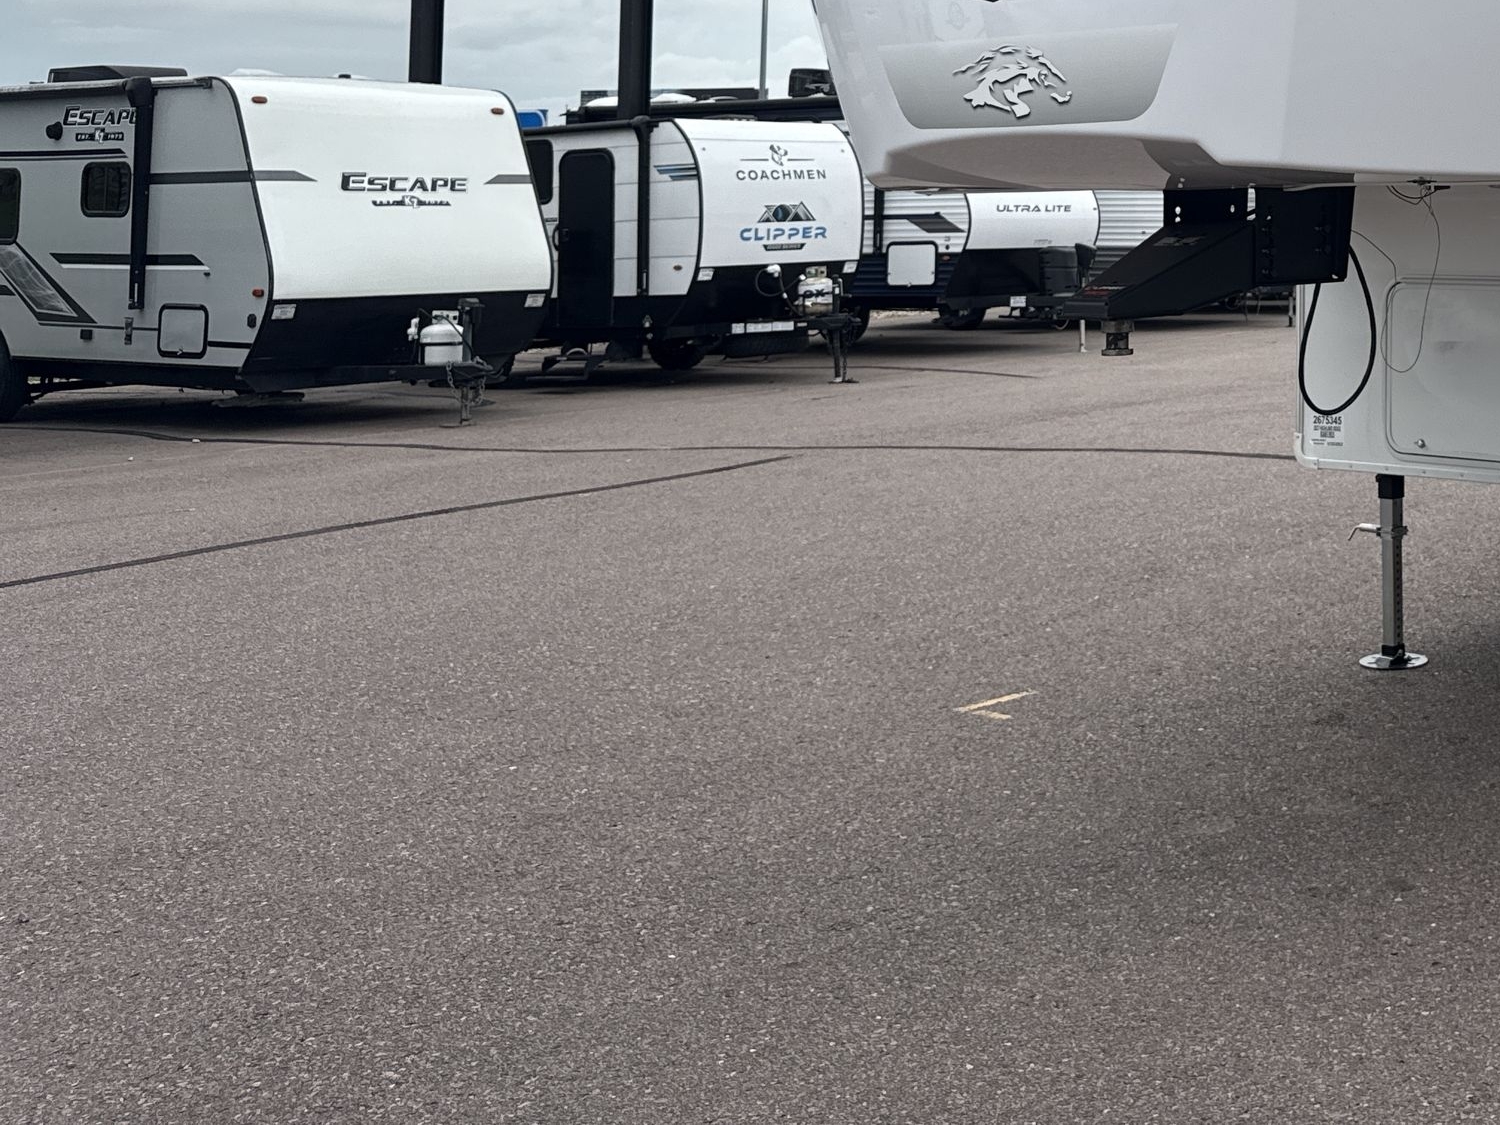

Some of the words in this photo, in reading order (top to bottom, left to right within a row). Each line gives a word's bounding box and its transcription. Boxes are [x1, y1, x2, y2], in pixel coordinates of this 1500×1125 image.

[736, 169, 827, 181] COACHMEN
[340, 171, 468, 192] ESCAPE
[996, 204, 1041, 213] ULTRA
[1044, 204, 1072, 213] LITE
[739, 226, 828, 241] CLIPPER
[1312, 415, 1342, 426] 2675345
